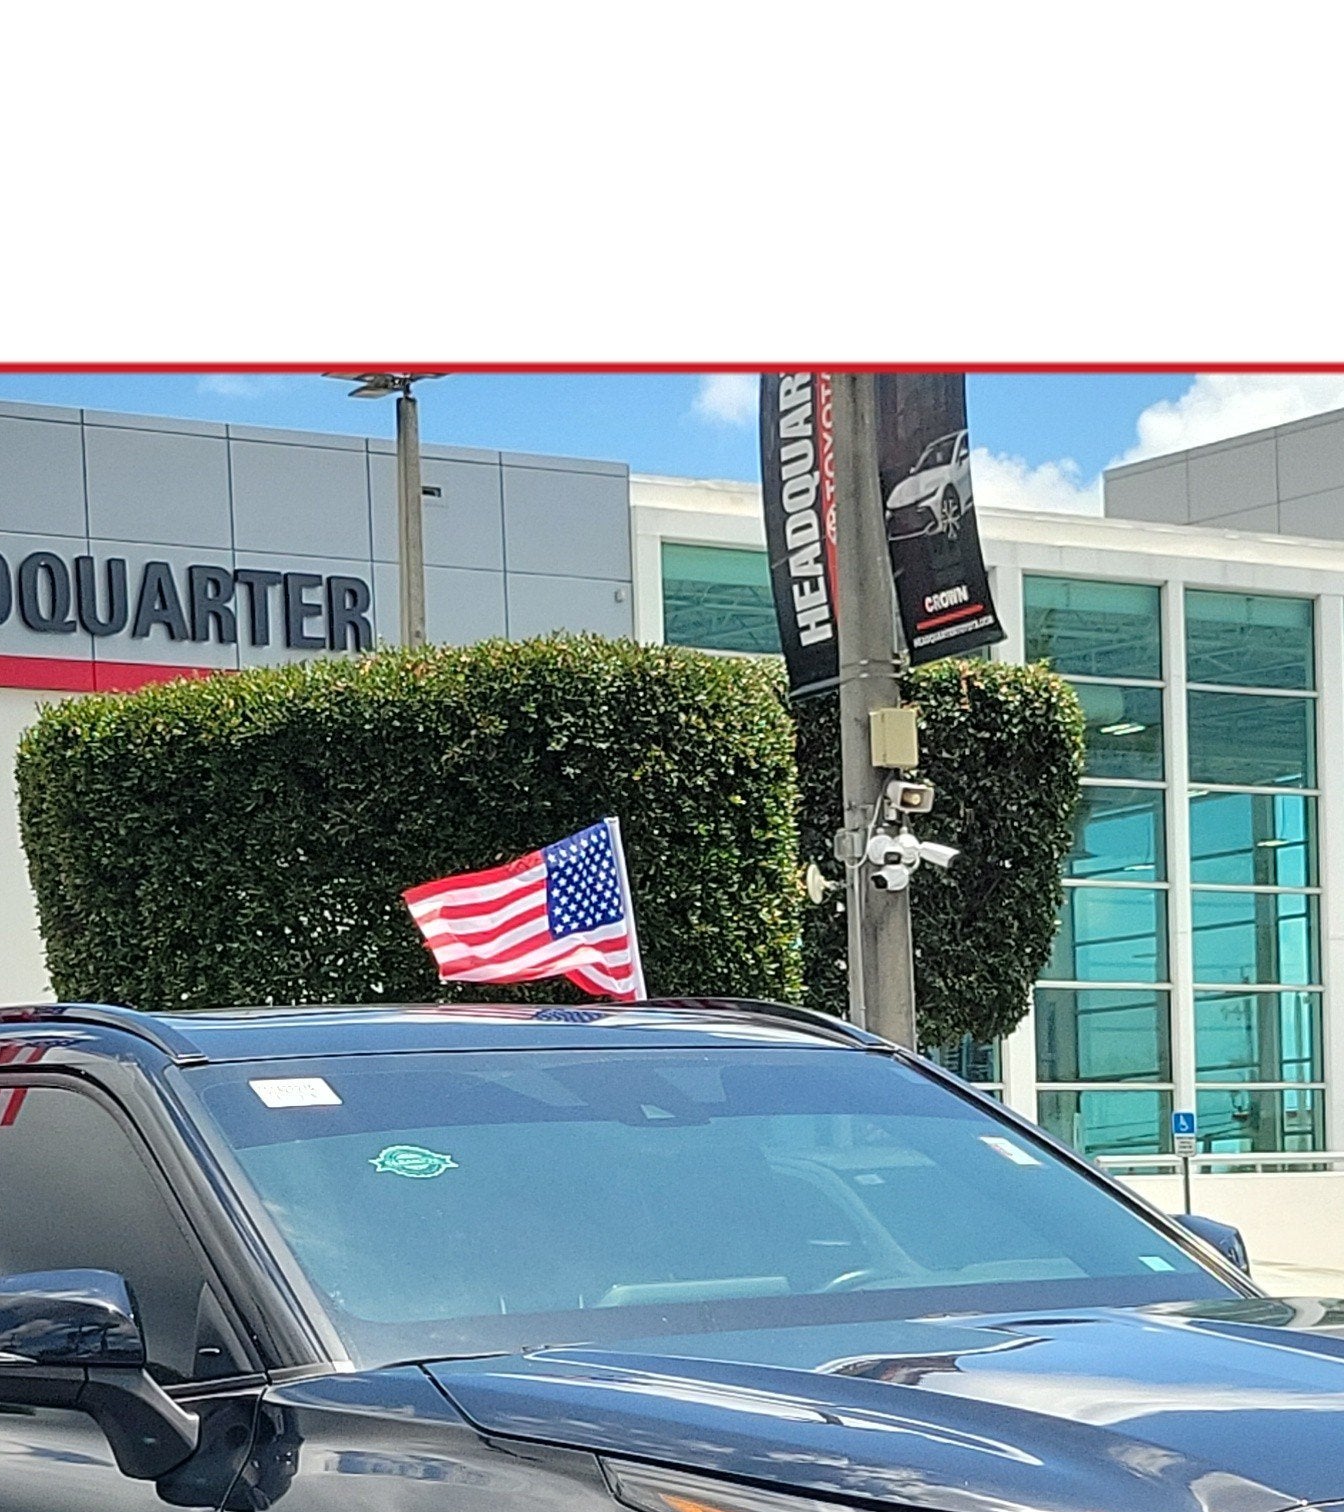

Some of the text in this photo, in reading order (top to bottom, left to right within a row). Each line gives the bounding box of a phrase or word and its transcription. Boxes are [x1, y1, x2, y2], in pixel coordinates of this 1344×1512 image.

[821, 373, 835, 501] TOYOT
[779, 373, 833, 647] HEADQUAR
[923, 584, 970, 613] CROWN
